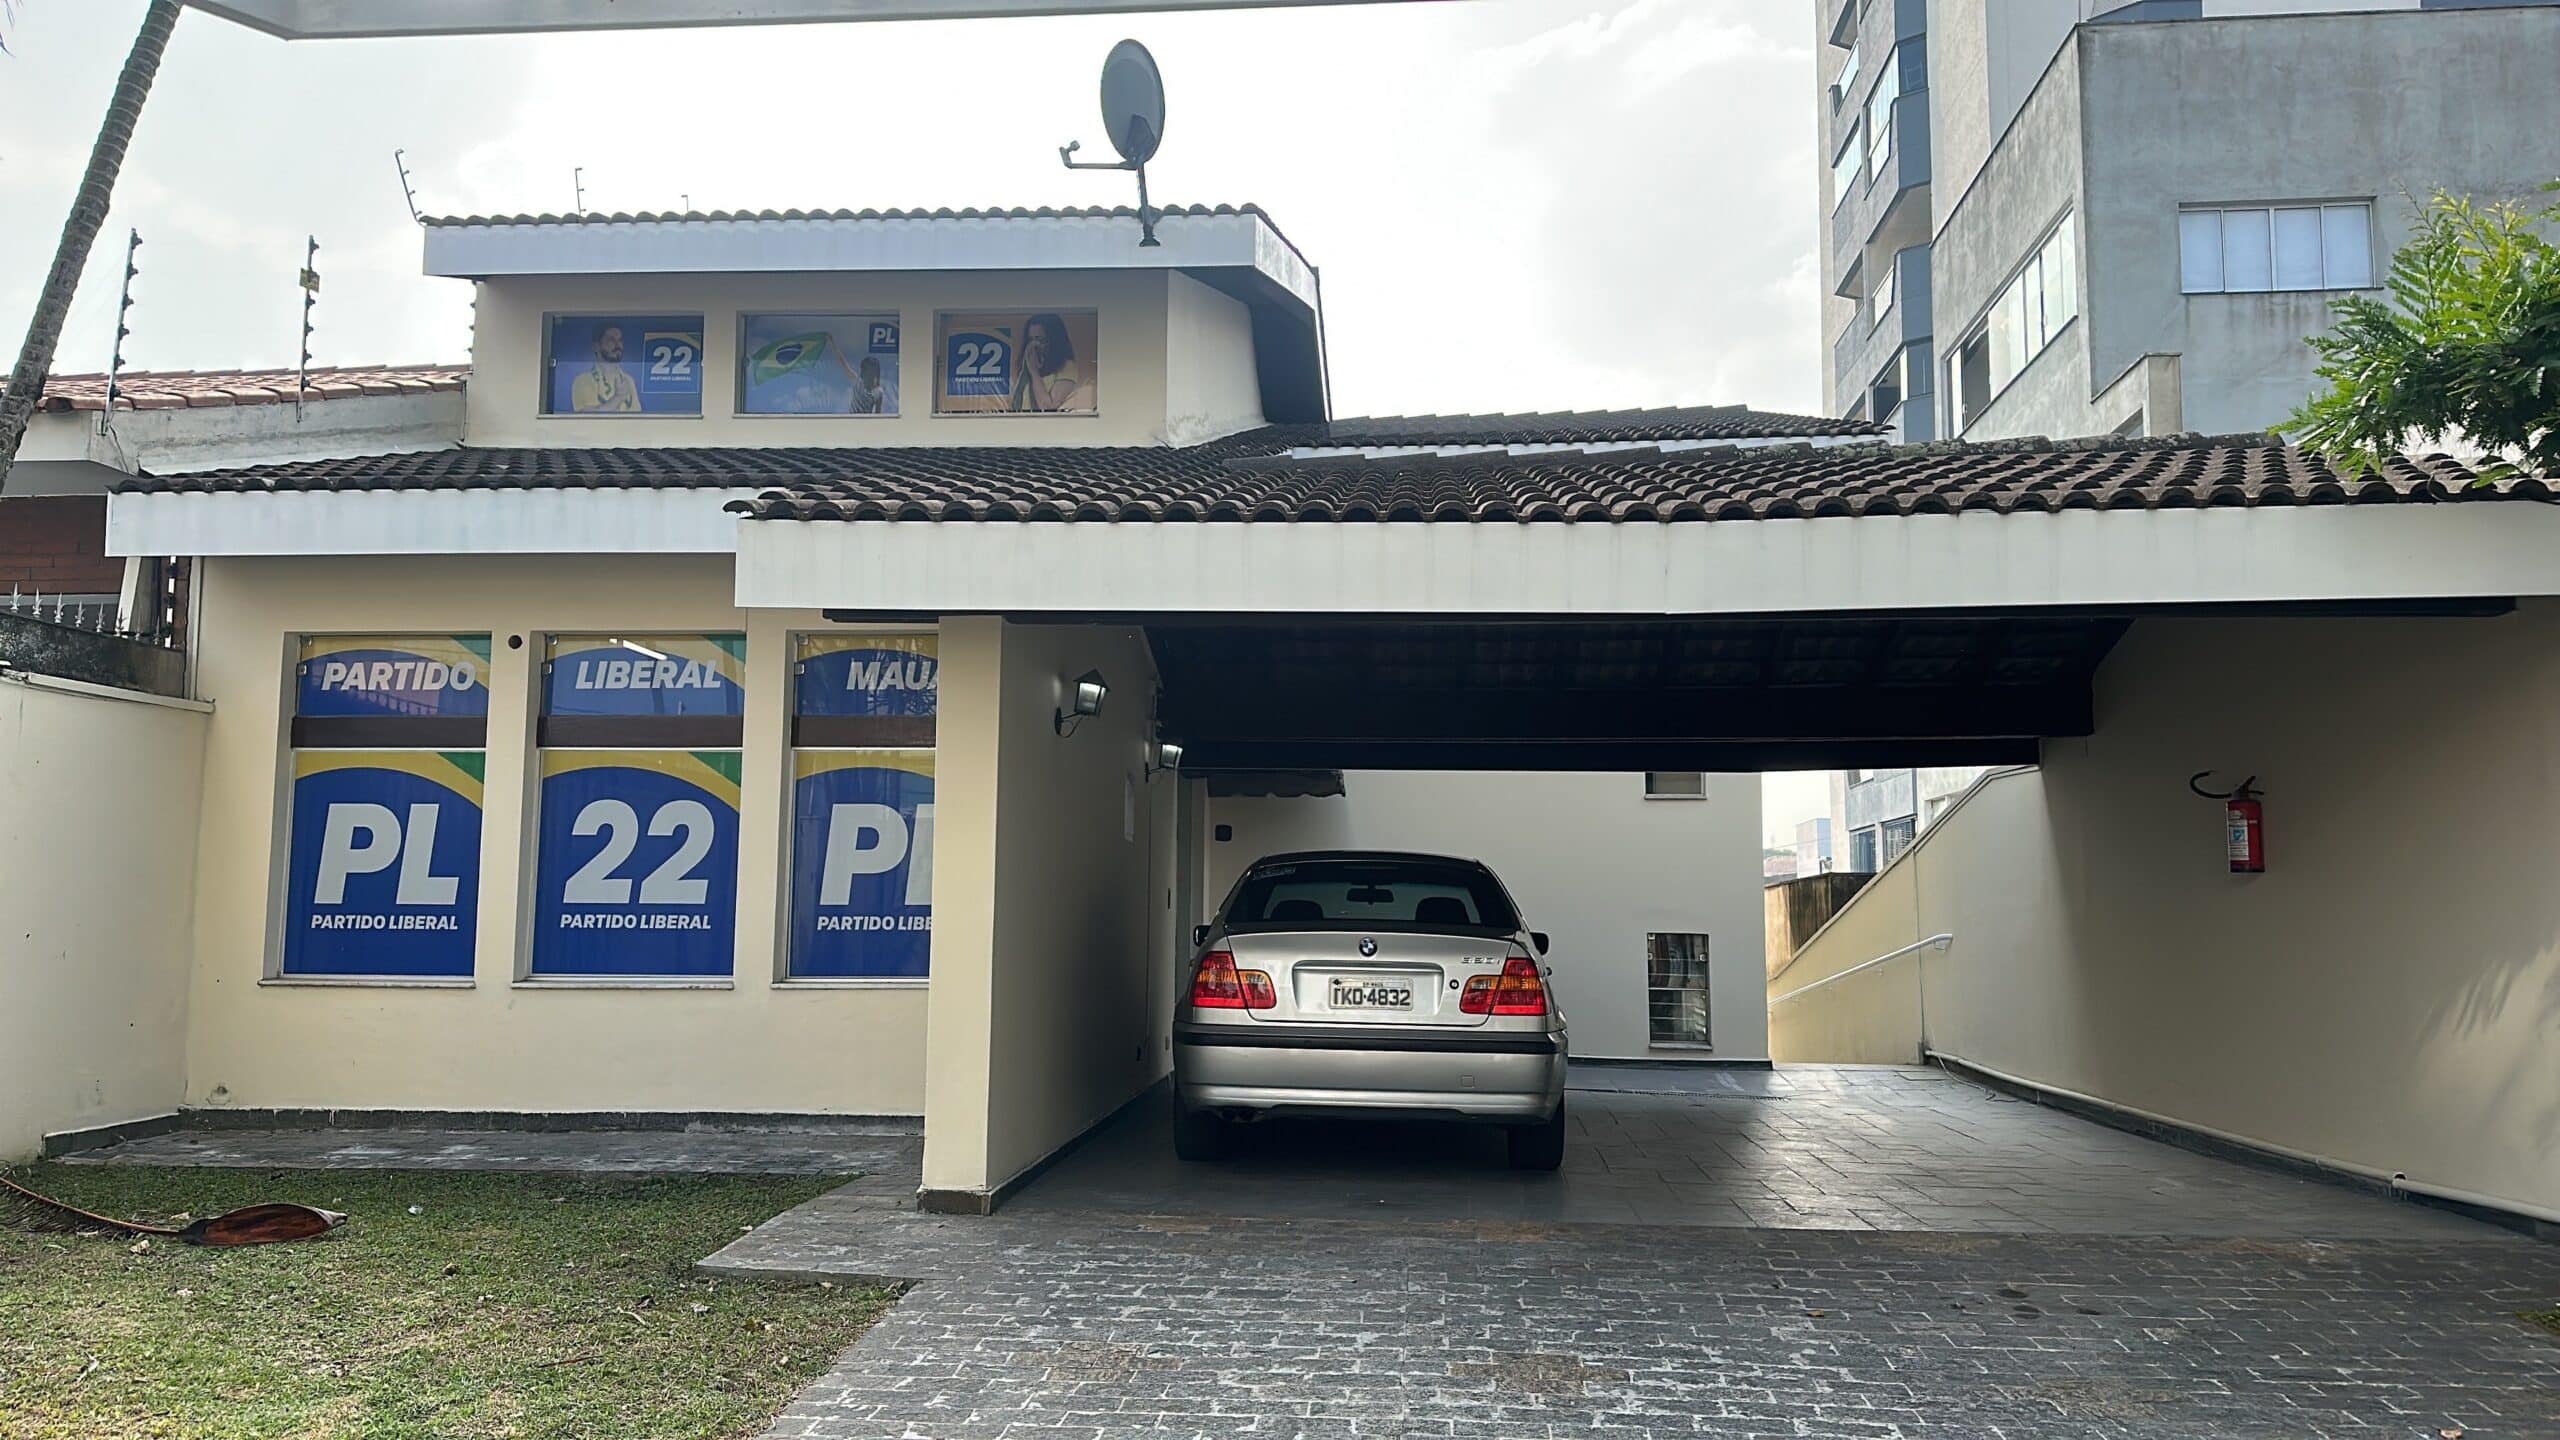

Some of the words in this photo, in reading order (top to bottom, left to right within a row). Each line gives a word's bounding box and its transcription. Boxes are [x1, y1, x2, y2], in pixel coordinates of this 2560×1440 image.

[873, 327, 896, 344] PL
[651, 346, 692, 374] 22
[956, 342, 1003, 374] 22
[321, 661, 476, 691] PARTIDO
[575, 660, 721, 689] LIBERAL
[314, 803, 459, 905] PL
[563, 799, 715, 904] 22
[311, 914, 386, 930] PARTIDO
[388, 915, 458, 930] LIBERAL
[560, 914, 637, 929] PARTIDO
[639, 915, 711, 929] LIBERAL
[817, 915, 895, 931] PARTIDO
